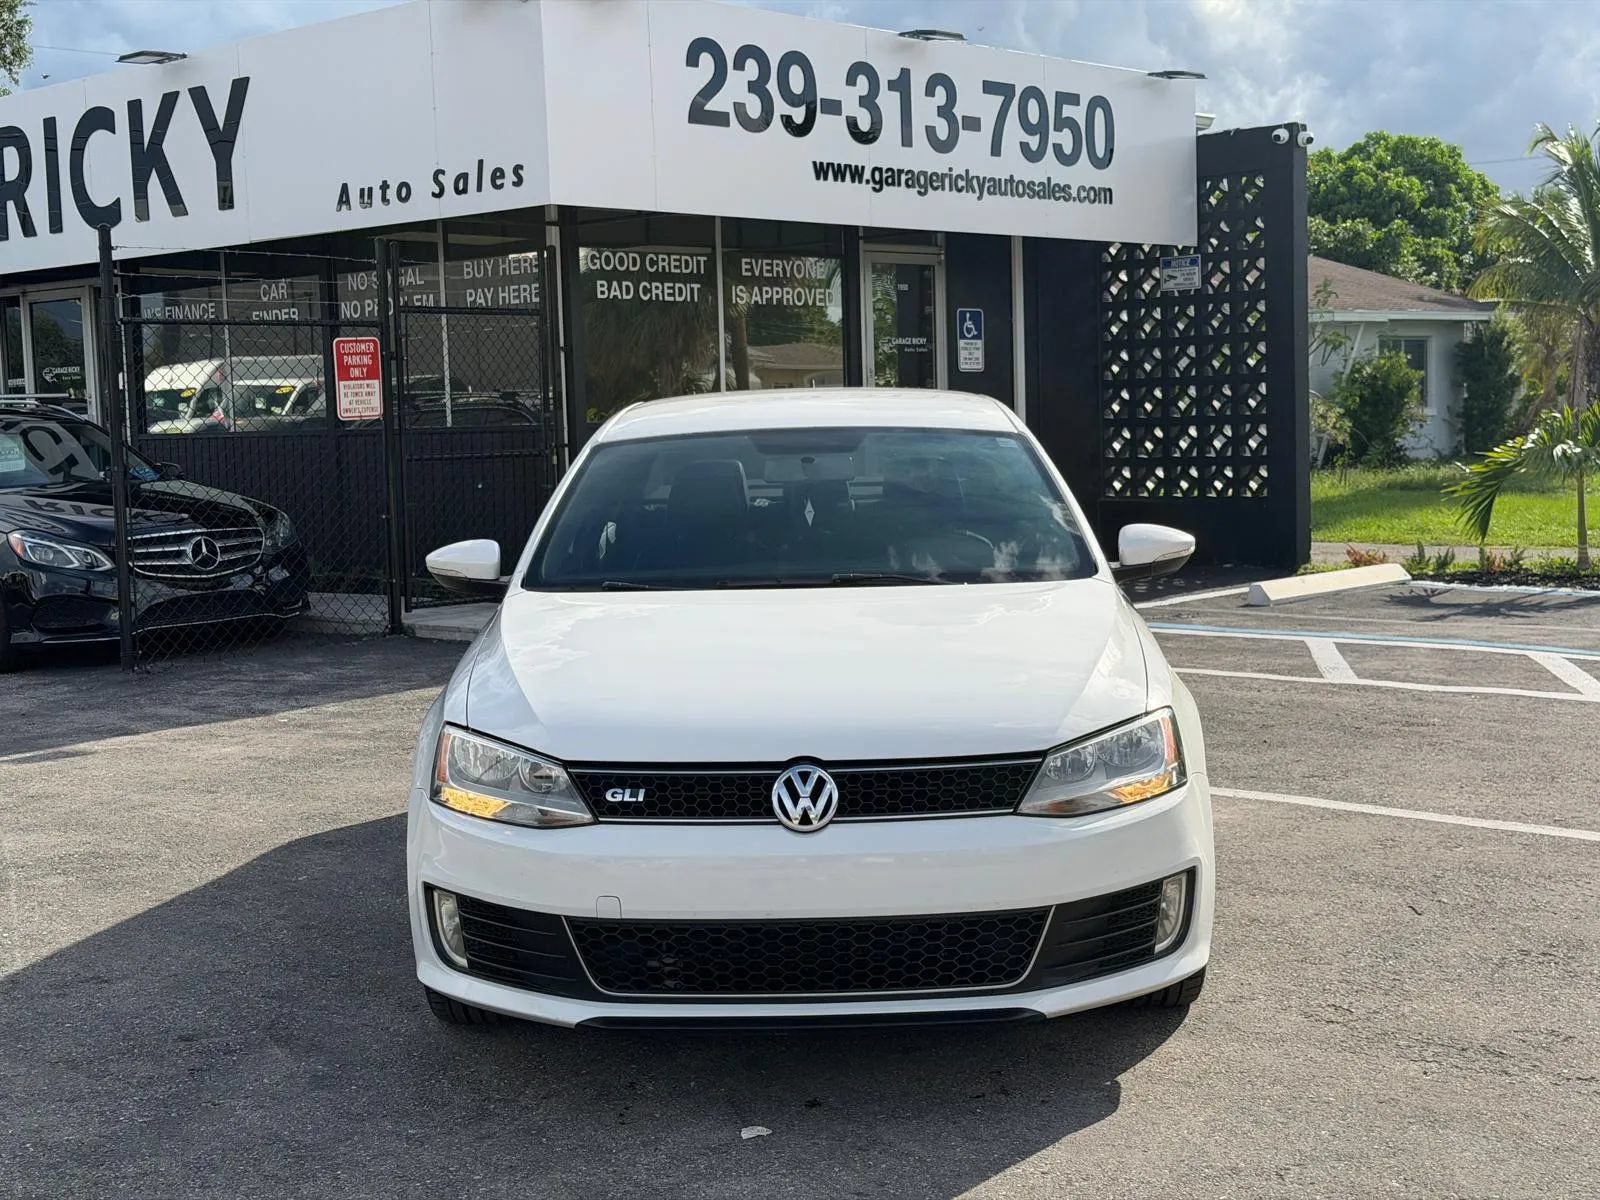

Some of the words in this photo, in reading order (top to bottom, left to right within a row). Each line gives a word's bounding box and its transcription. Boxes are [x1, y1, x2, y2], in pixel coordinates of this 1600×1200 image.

[686, 37, 1115, 170] 239-313-7950
[0, 76, 250, 242] RICKY
[336, 180, 412, 212] Auto
[431, 158, 524, 199] Sales
[812, 160, 1113, 205] www.garagerickyautosales.com
[463, 259, 495, 280] BUY
[500, 255, 539, 276] HERE
[586, 251, 641, 272] GOOD
[645, 253, 708, 275] CREDIT
[741, 258, 827, 280] EVERYONE
[260, 283, 287, 302] CAR
[347, 272, 368, 291] NO
[596, 280, 634, 300] BAD
[638, 282, 701, 303] CREDIT
[466, 287, 495, 307] PAY
[499, 283, 540, 305] HERE
[732, 285, 747, 304] IS
[751, 286, 835, 307] APPROVED
[165, 302, 216, 320] FINANCE
[341, 300, 361, 319] NO
[340, 342, 375, 354] CUSTOMER
[343, 355, 373, 366] PARKING
[349, 367, 368, 378] ONLY
[605, 788, 646, 802] GLI
